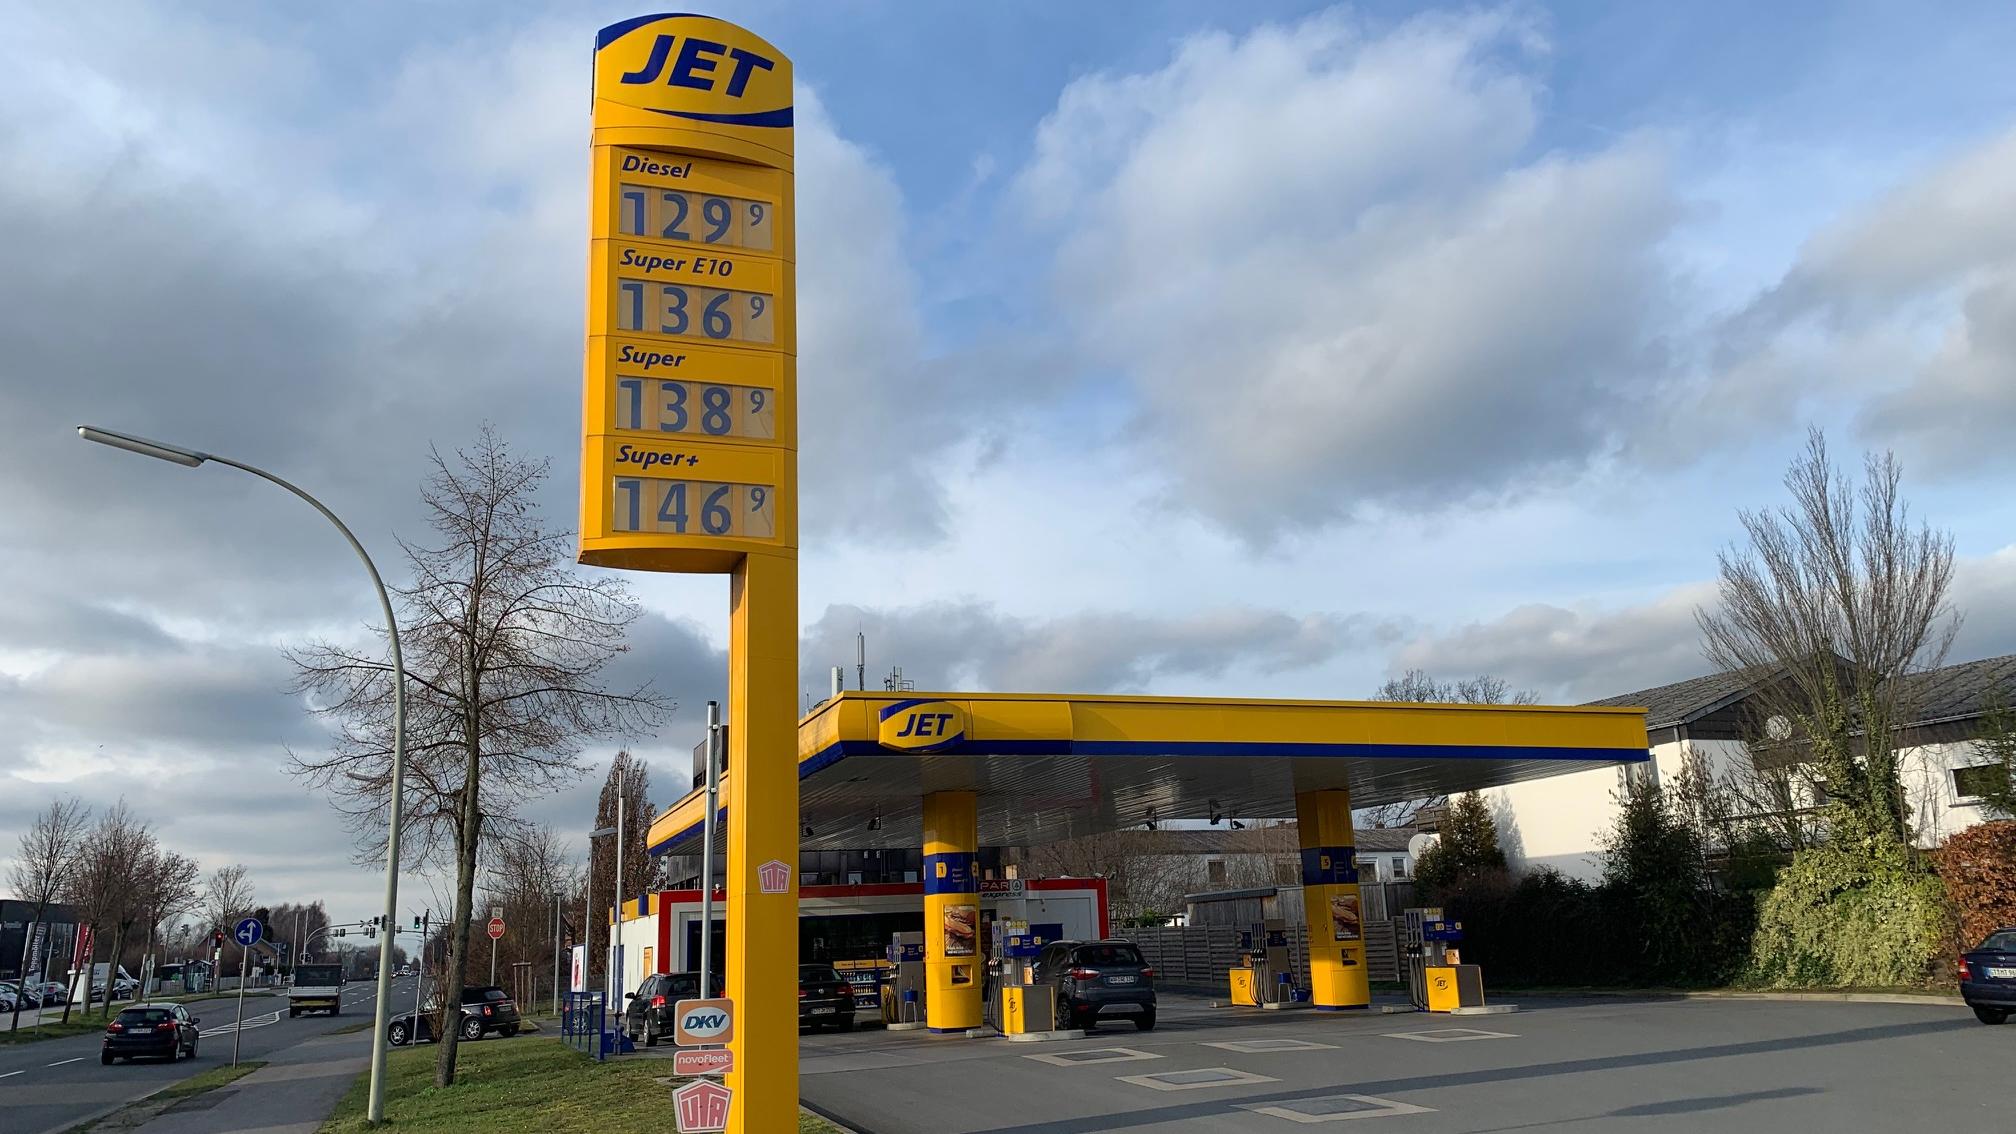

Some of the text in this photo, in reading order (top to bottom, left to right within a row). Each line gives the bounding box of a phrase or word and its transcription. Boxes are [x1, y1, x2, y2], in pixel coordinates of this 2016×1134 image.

[620, 34, 775, 98] JET
[621, 155, 692, 179] Diesel
[619, 249, 733, 277] Super E10
[618, 345, 686, 370] Super
[616, 445, 699, 470] Super+
[896, 713, 954, 737] JET
[759, 862, 789, 891] UTA
[980, 882, 1009, 890] PAR
[490, 924, 503, 932] STOP
[684, 1014, 727, 1030] DKV
[678, 1053, 729, 1065] novofleet
[680, 1083, 728, 1129] UTA
